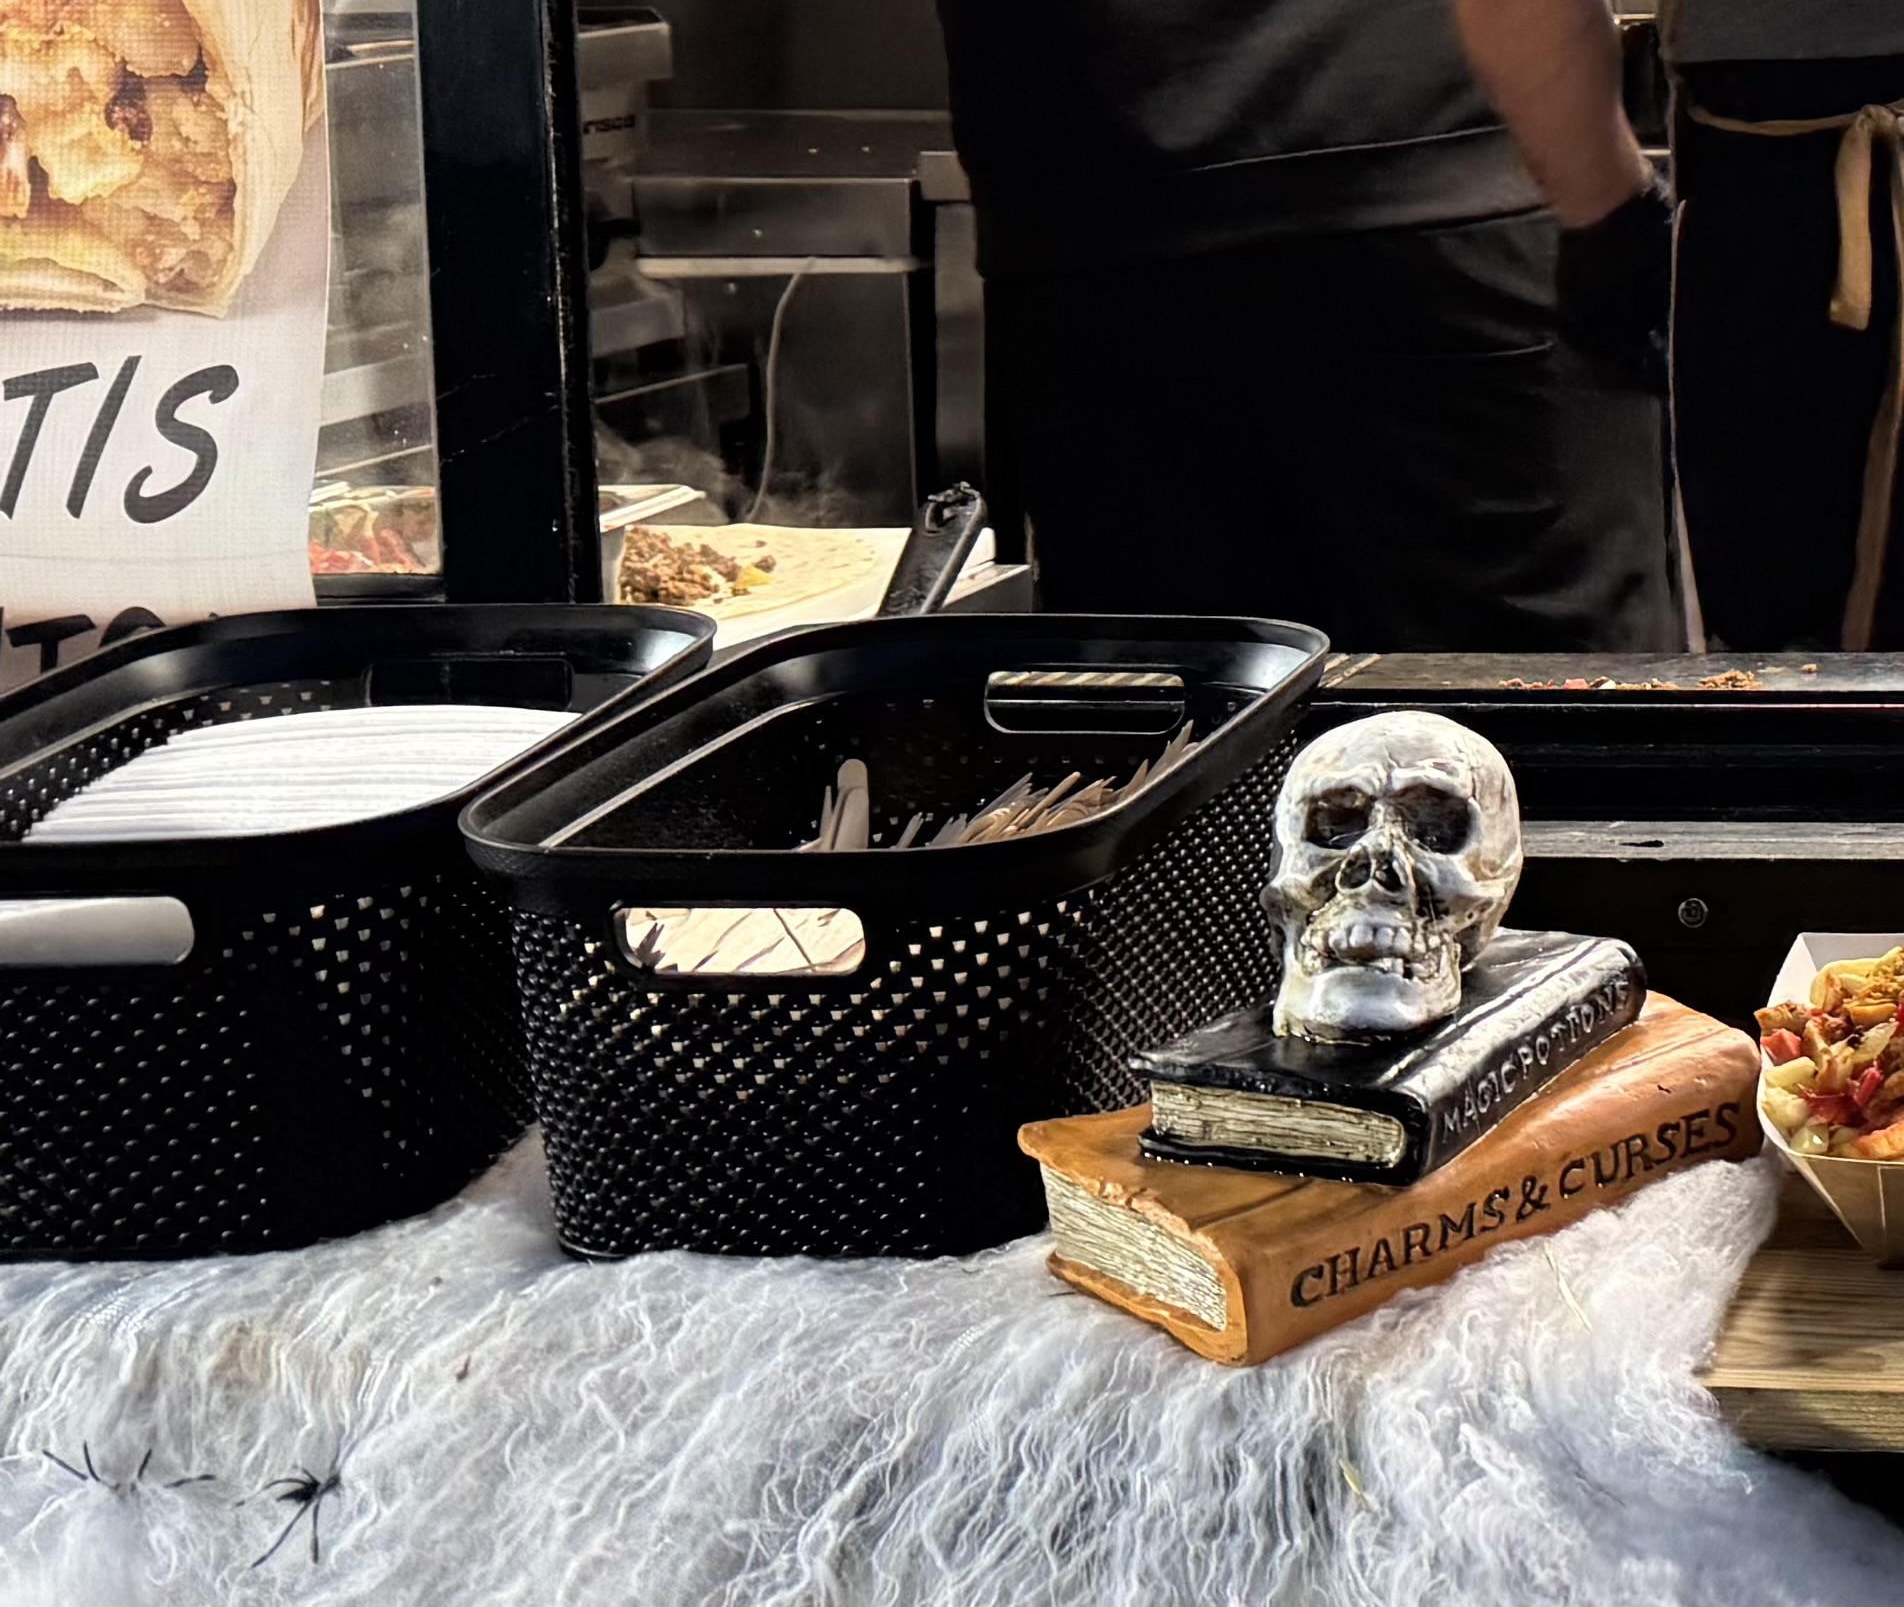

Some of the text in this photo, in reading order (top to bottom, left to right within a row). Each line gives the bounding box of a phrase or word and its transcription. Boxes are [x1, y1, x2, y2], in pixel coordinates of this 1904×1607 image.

[0, 354, 240, 525] TIS
[1289, 1102, 1741, 1309] CHARMS & CURSES
